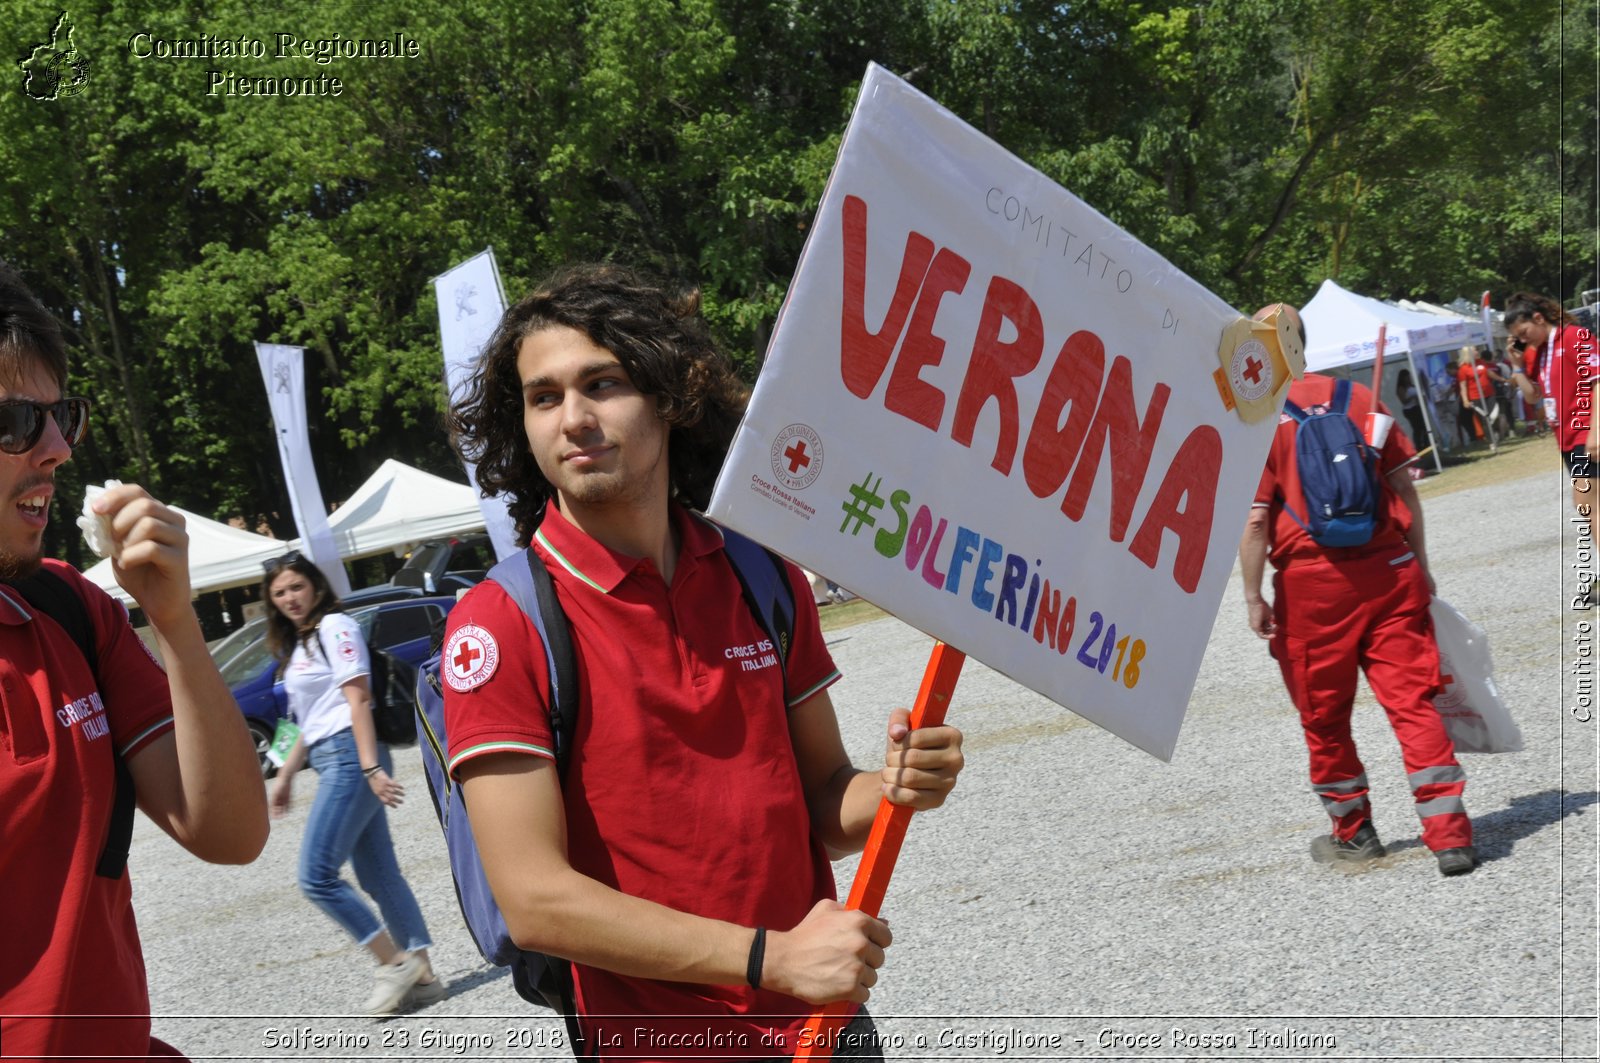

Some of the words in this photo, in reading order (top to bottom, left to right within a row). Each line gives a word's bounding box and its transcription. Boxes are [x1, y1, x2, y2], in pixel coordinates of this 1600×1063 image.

[986, 187, 1132, 293] COMITATO
[1162, 308, 1180, 335] DI
[840, 194, 1223, 594] VERONA
[752, 474, 771, 490] Croce
[772, 485, 791, 501] Rossa
[792, 497, 816, 515] Italiana
[1076, 611, 1147, 689] 2018
